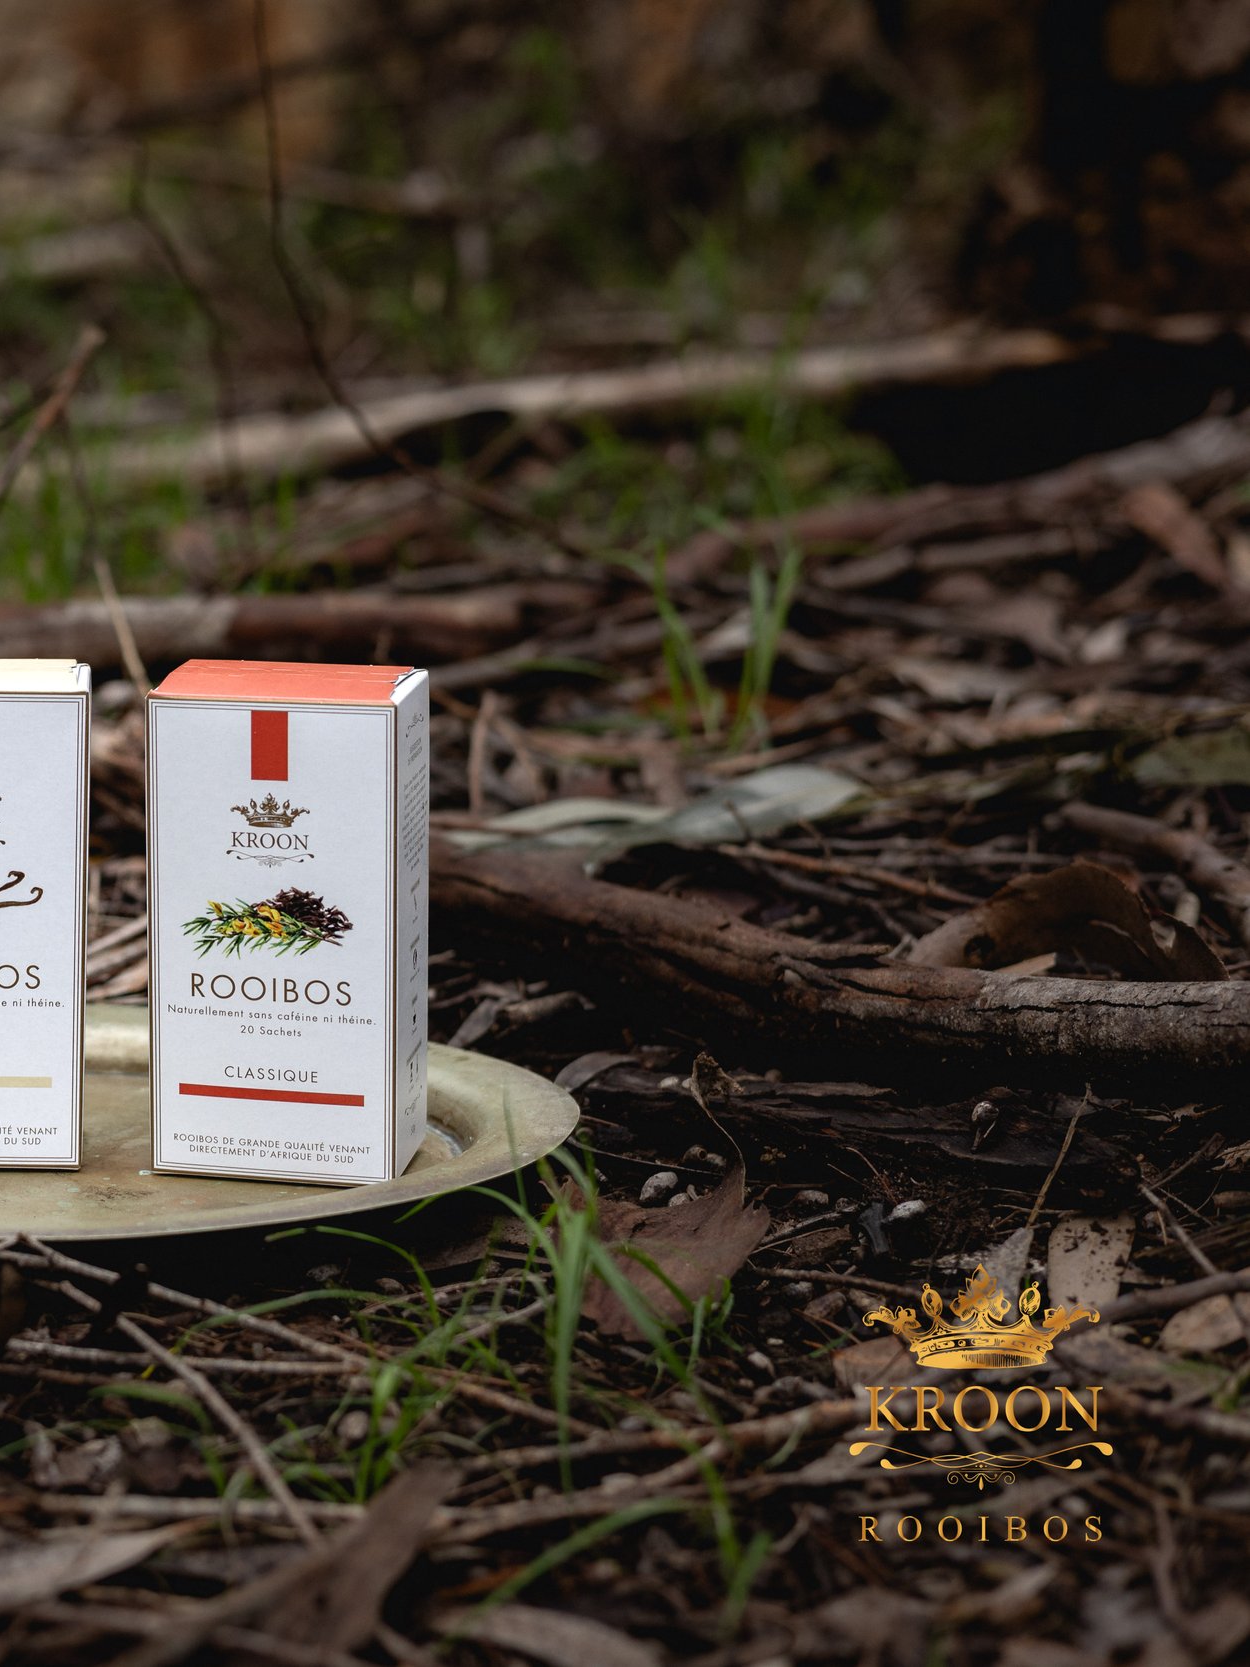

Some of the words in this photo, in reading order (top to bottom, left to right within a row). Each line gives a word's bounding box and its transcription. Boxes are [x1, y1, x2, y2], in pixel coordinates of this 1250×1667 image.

[231, 832, 309, 850] KROON
[191, 973, 352, 1006] ROOIBOS
[12, 998, 22, 1007] ni
[27, 998, 65, 1008] théine.
[167, 1004, 244, 1018] Naturellement
[249, 1012, 273, 1020] sans
[277, 1012, 318, 1023] caféine
[323, 1014, 333, 1023] ni
[338, 1014, 377, 1026] théine.
[240, 1025, 254, 1034] 20
[259, 1026, 302, 1037] Sachets
[224, 1065, 318, 1084] CLASSIQUE
[17, 1127, 57, 1135] VENANT
[4, 1137, 17, 1145] DU
[22, 1137, 41, 1146] SUD
[173, 1133, 218, 1144] ROOIBOS
[223, 1137, 234, 1145] DE
[238, 1138, 280, 1149] GRANDE
[284, 1141, 325, 1152] QUALITÉ
[329, 1145, 370, 1155] VENANT
[189, 1145, 255, 1157] DIRECTEMENT
[260, 1150, 312, 1161] D'AFRIQUE
[316, 1154, 330, 1162] DU
[334, 1155, 354, 1164] SUD
